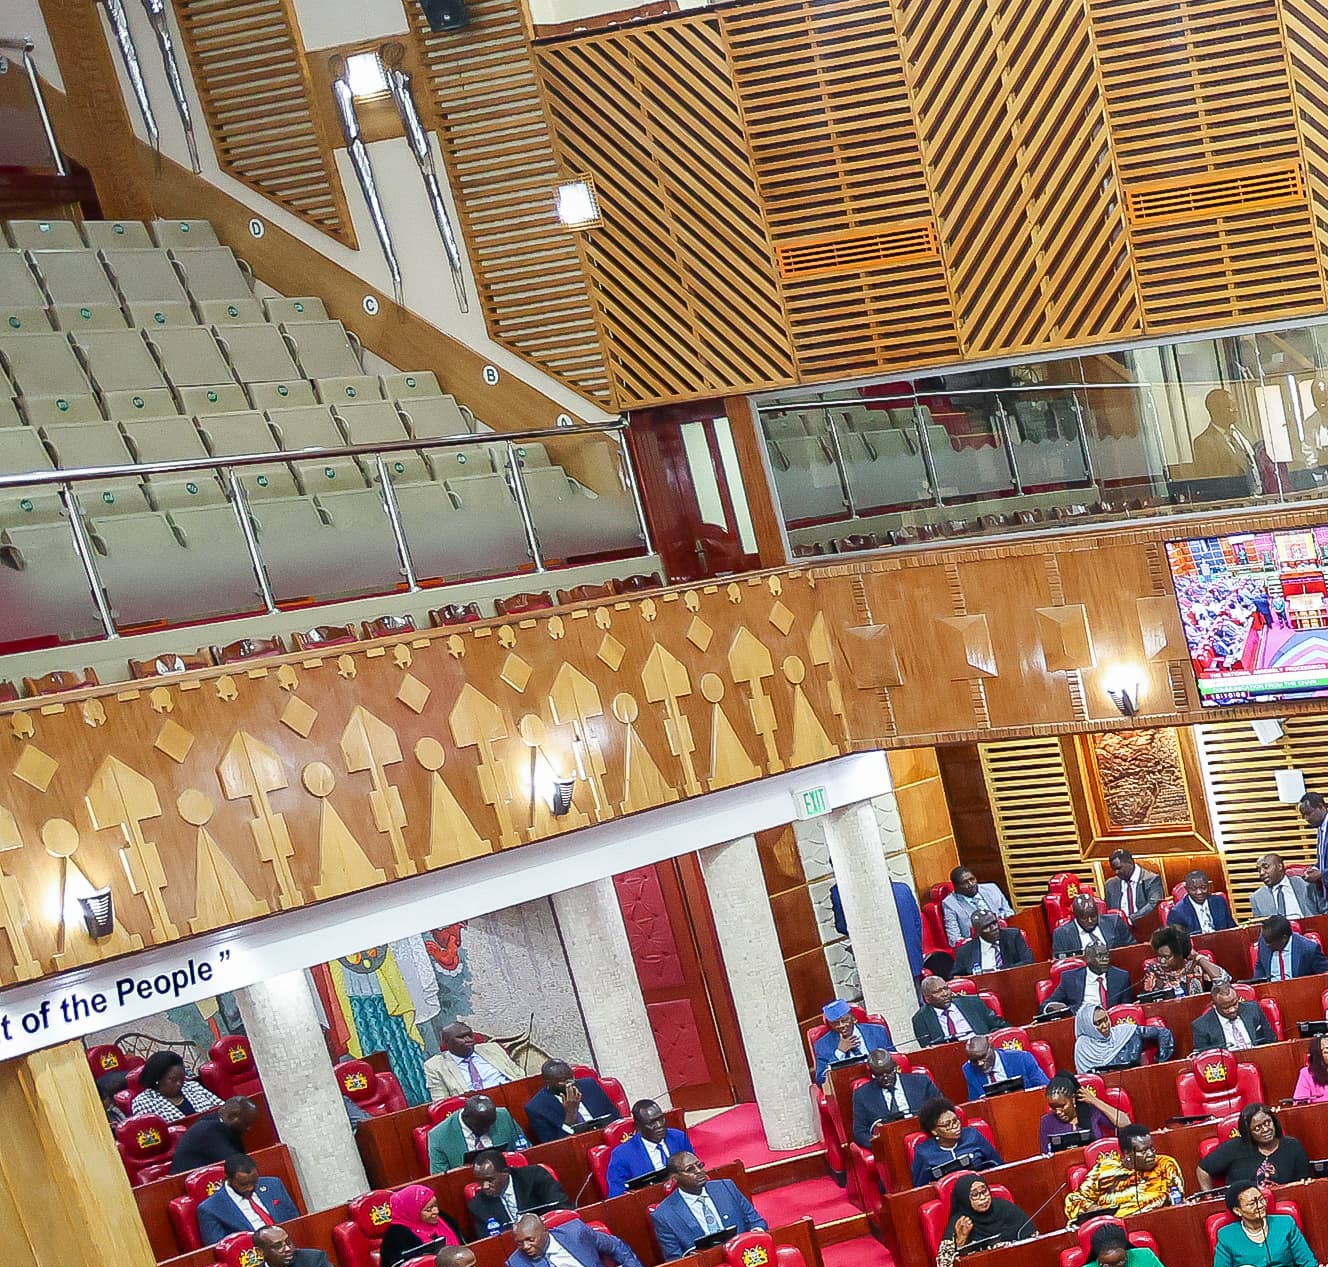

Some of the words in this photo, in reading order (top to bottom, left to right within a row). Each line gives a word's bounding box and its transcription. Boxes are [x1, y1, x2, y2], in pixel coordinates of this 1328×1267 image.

[251, 221, 261, 235] D
[365, 298, 375, 312] C
[486, 368, 496, 382] B
[803, 788, 826, 816] EXIT
[21, 1000, 50, 1035] of
[60, 992, 107, 1023] the
